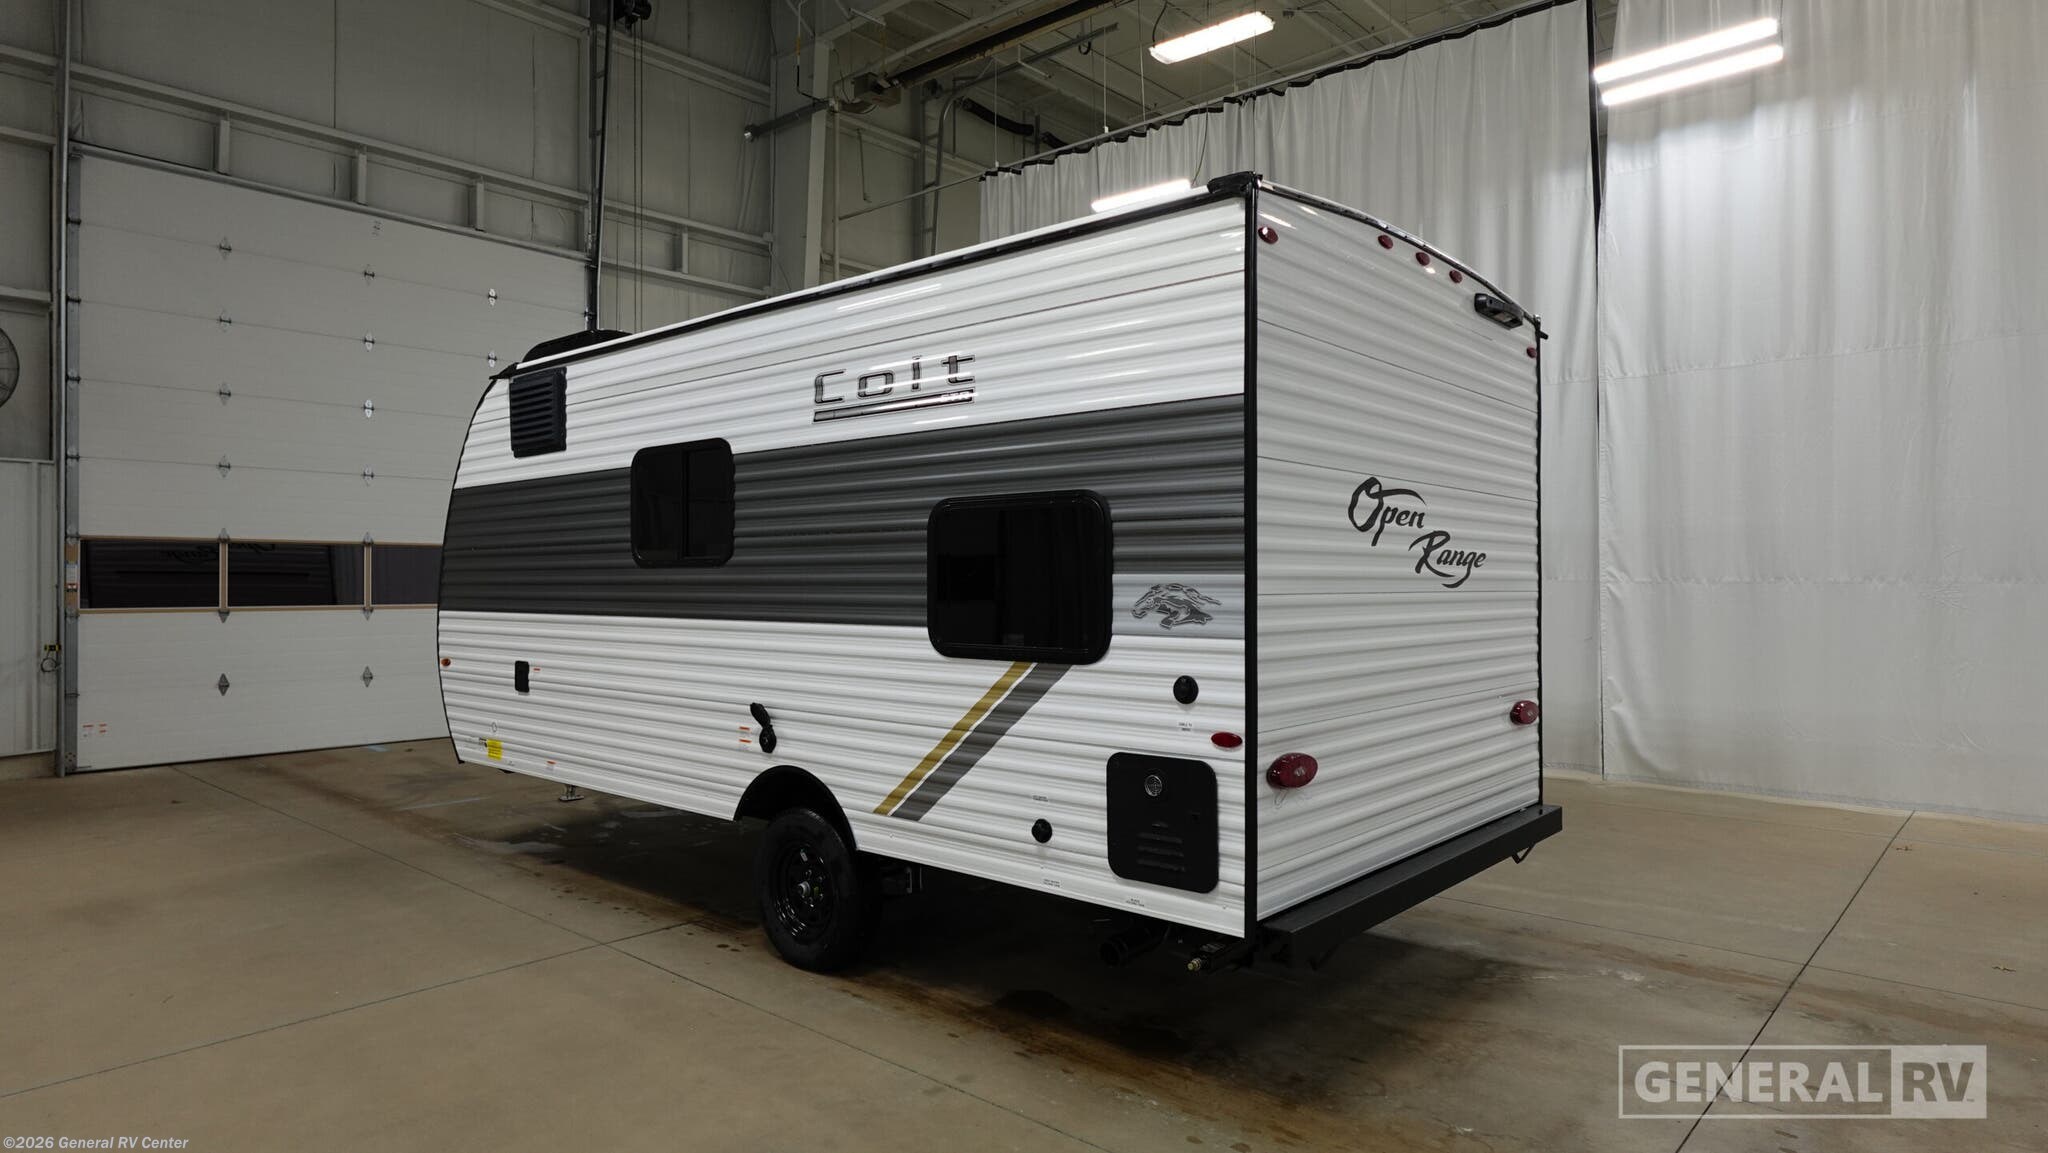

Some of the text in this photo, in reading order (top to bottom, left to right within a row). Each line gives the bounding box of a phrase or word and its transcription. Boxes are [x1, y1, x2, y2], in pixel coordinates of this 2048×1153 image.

[814, 354, 976, 404] Colt
[1348, 476, 1427, 546] Open
[1408, 530, 1487, 589] Range
